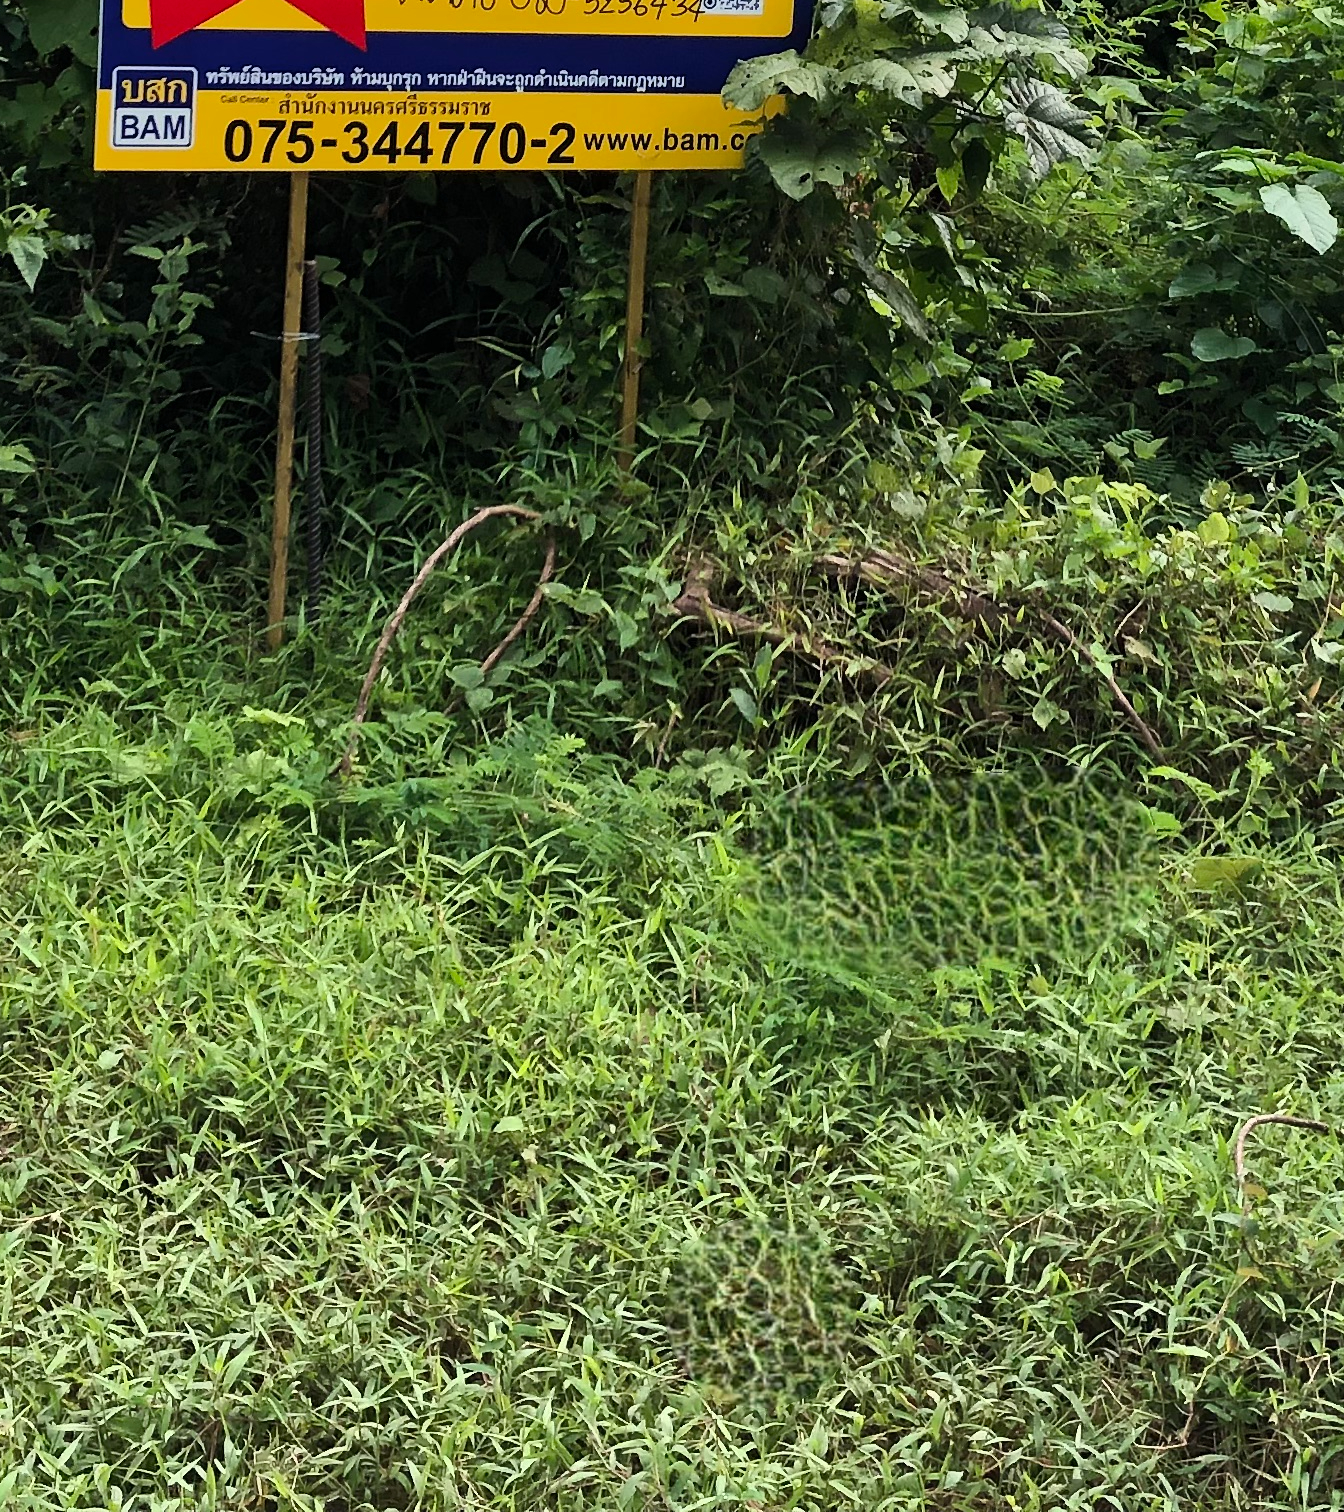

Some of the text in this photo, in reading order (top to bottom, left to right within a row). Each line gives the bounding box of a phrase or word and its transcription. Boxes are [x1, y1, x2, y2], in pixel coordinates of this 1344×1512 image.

[122, 77, 188, 103] บสก
[205, 65, 345, 86] ทรัพย์สินของบริษัท
[350, 67, 422, 92] ห้ามบุกรุก
[278, 92, 491, 116] สำนักงานนครศรีธรรมราช
[120, 115, 186, 140] BAM
[224, 118, 758, 165] 075-344770-2 www.bam.c
